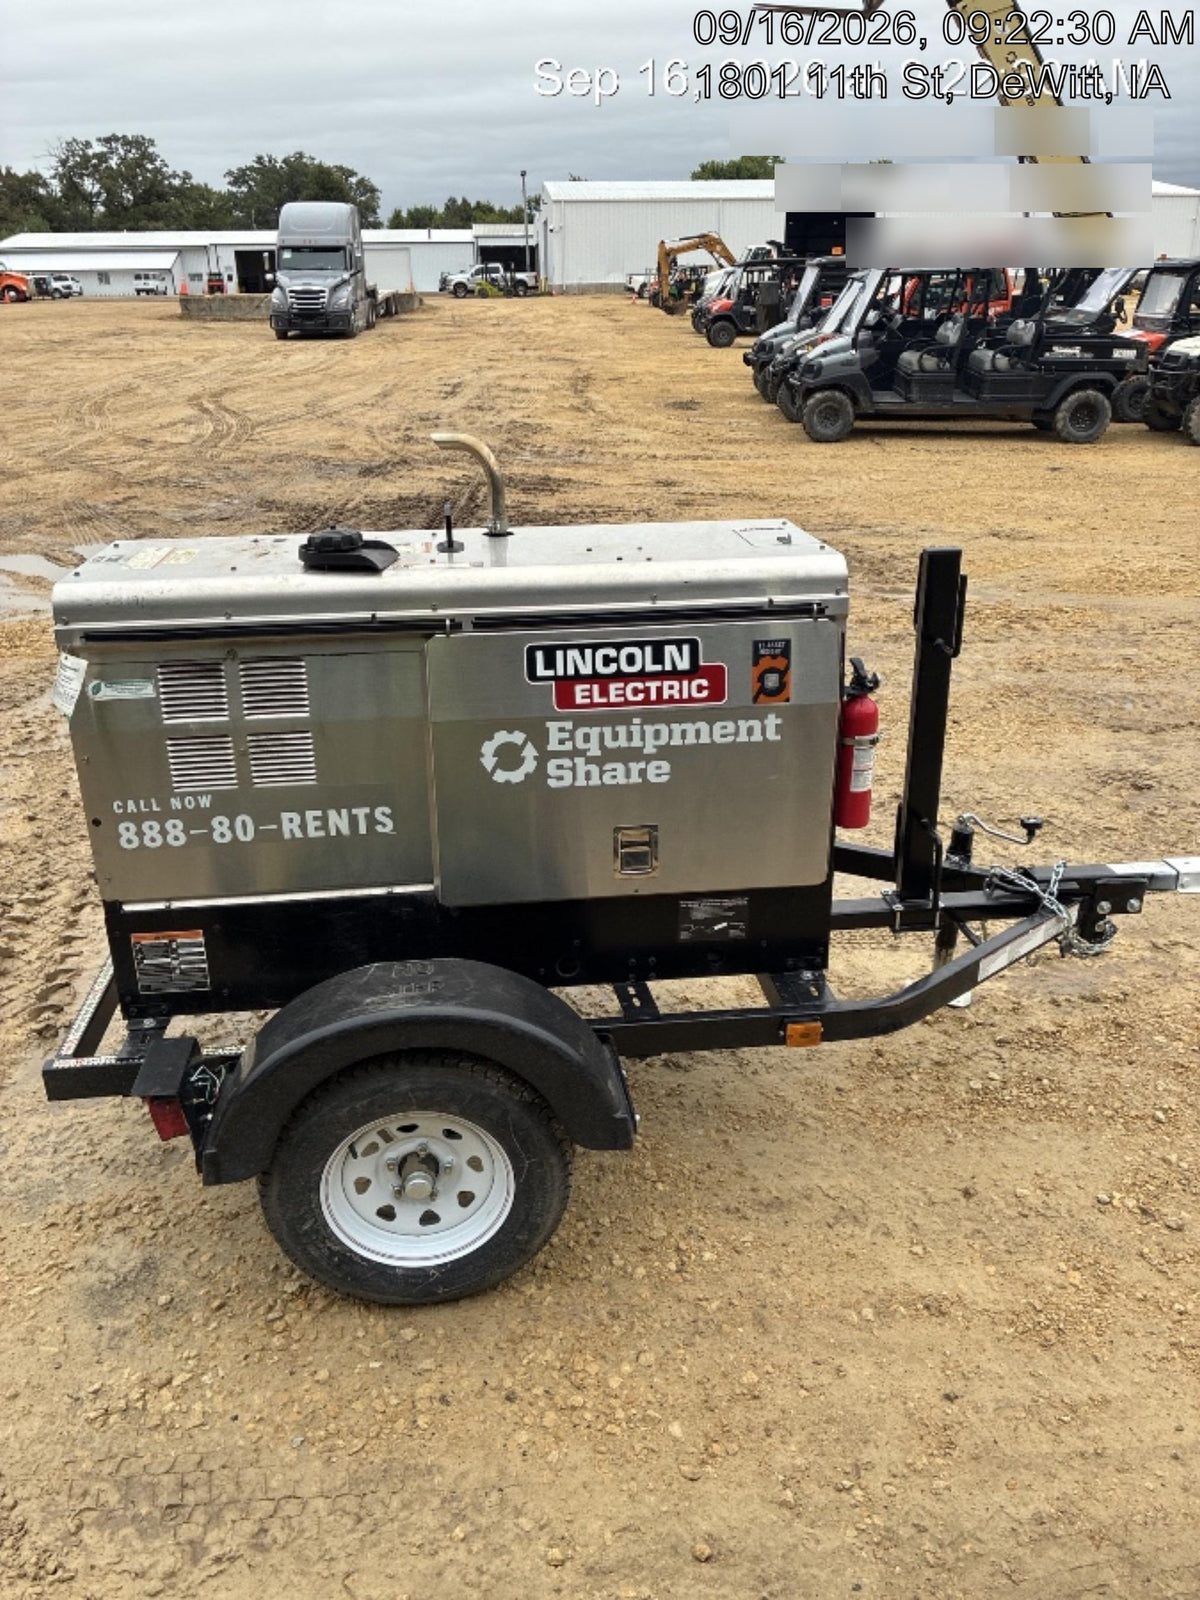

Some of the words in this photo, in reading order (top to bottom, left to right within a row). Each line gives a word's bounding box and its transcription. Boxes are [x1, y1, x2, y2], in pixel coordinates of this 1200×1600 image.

[535, 644, 691, 677] LINCOLN
[574, 679, 710, 705] ELECTRIC
[546, 713, 783, 755] Equipment
[547, 757, 671, 788] Share
[112, 800, 161, 814] CALL
[170, 795, 212, 810] NOW
[118, 806, 395, 849] 888-80-RENTS
